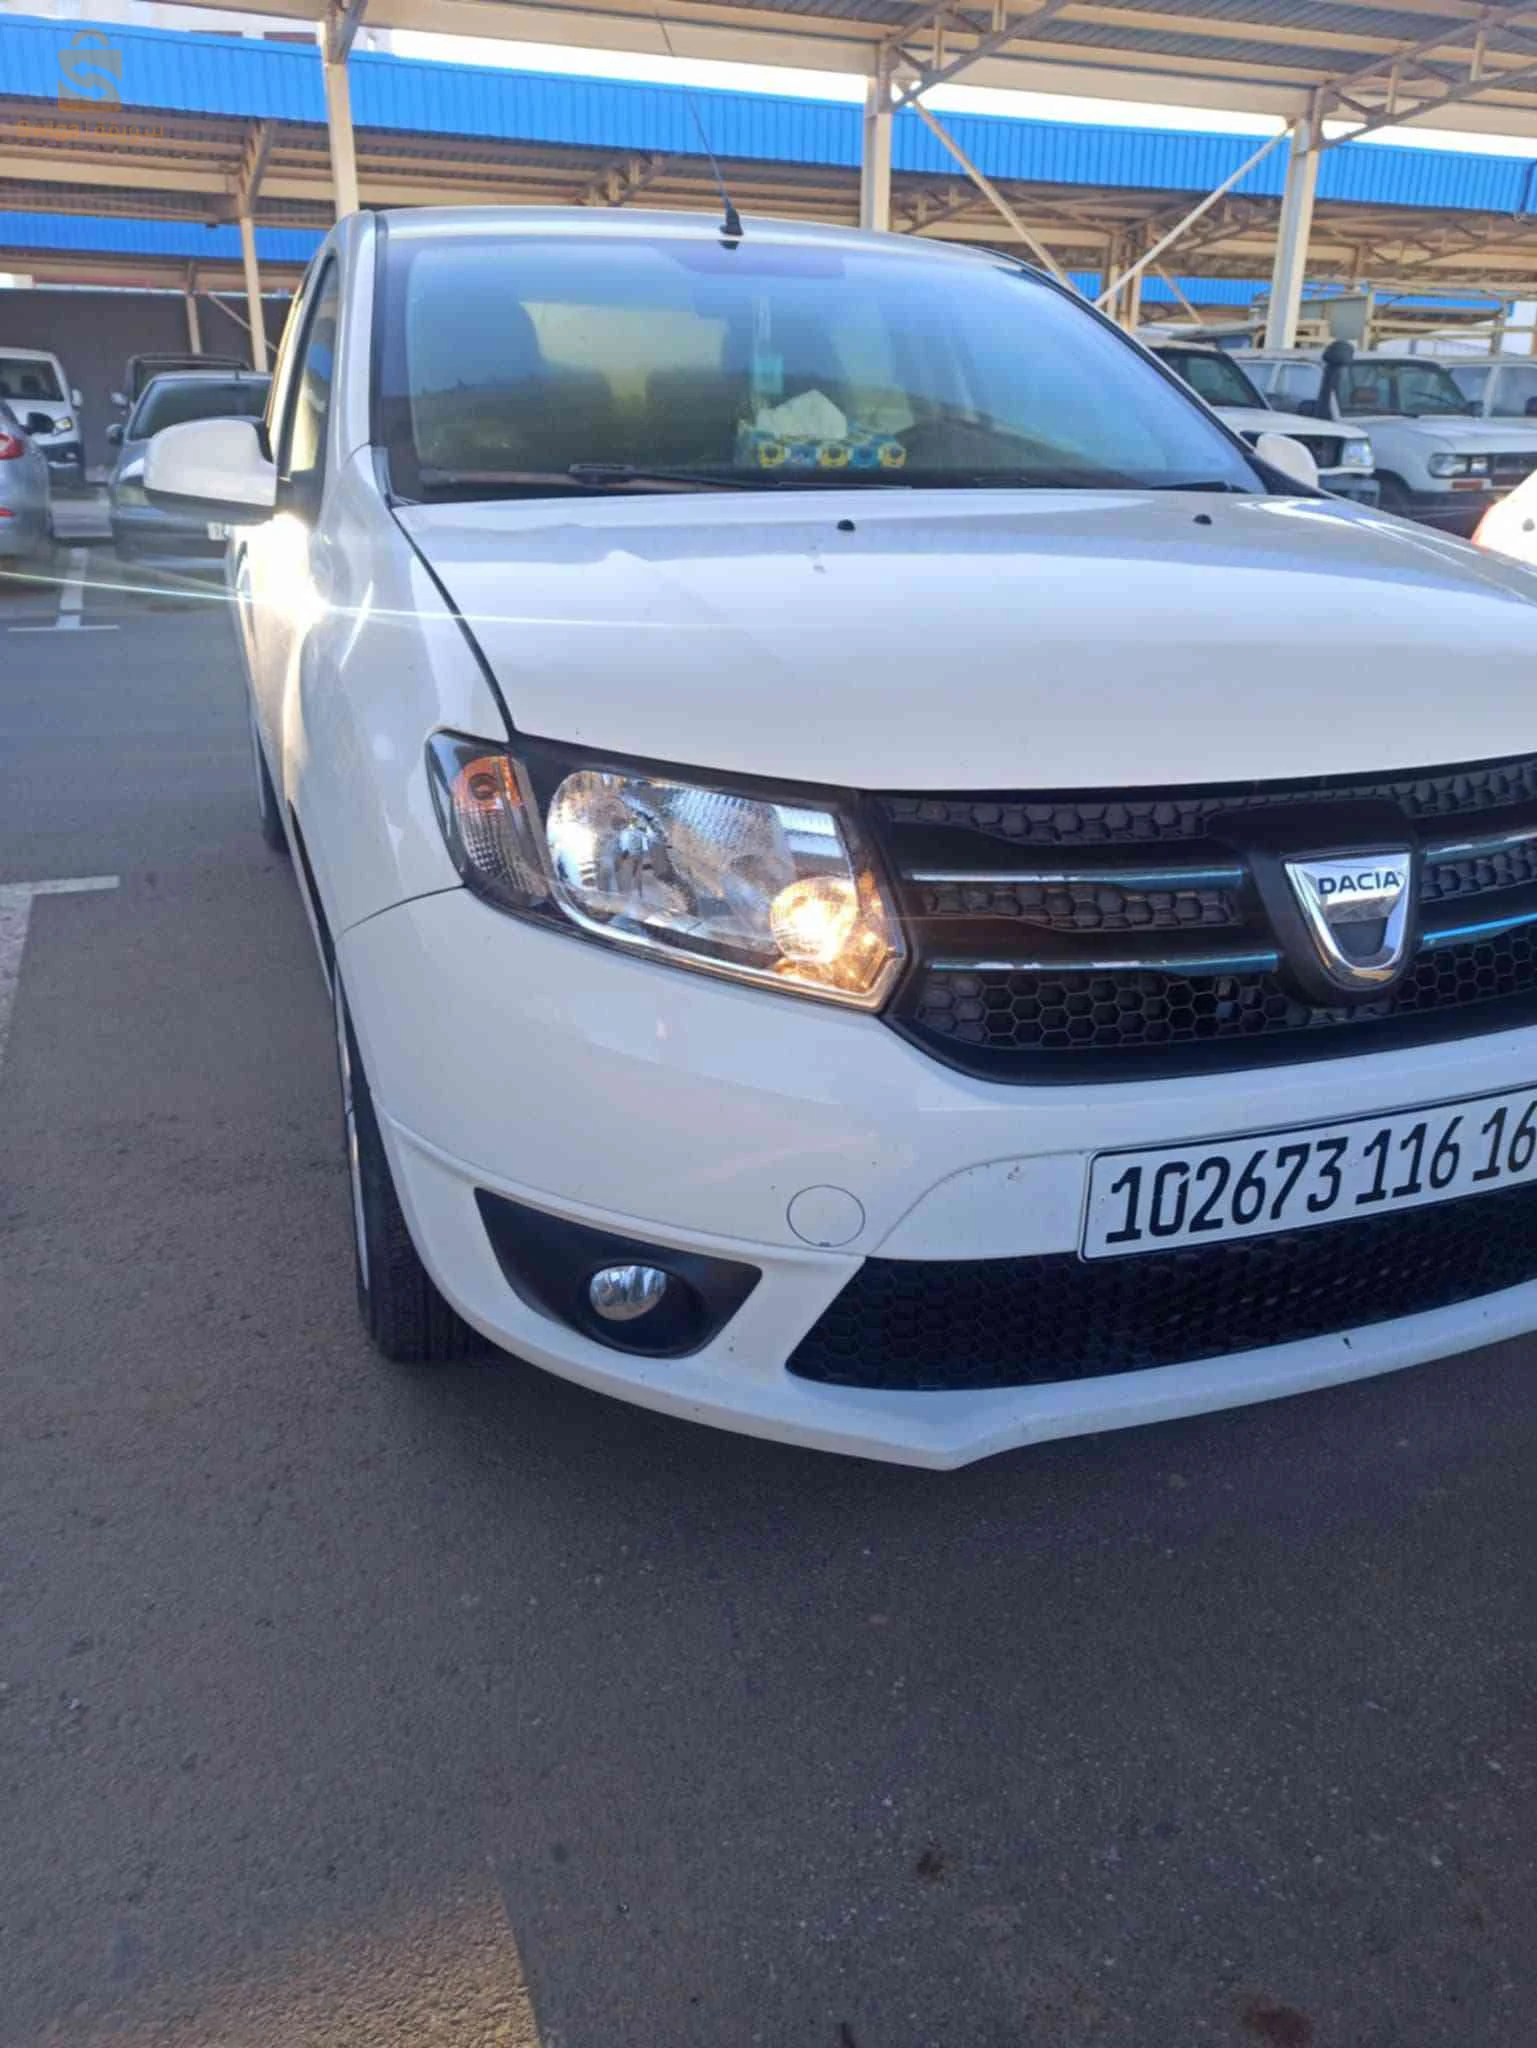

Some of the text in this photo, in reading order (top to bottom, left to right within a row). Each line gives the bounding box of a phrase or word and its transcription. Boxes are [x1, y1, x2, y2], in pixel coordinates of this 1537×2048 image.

[1317, 871, 1401, 895] DACIA
[1105, 1100, 1537, 1244] 102673 116 16
